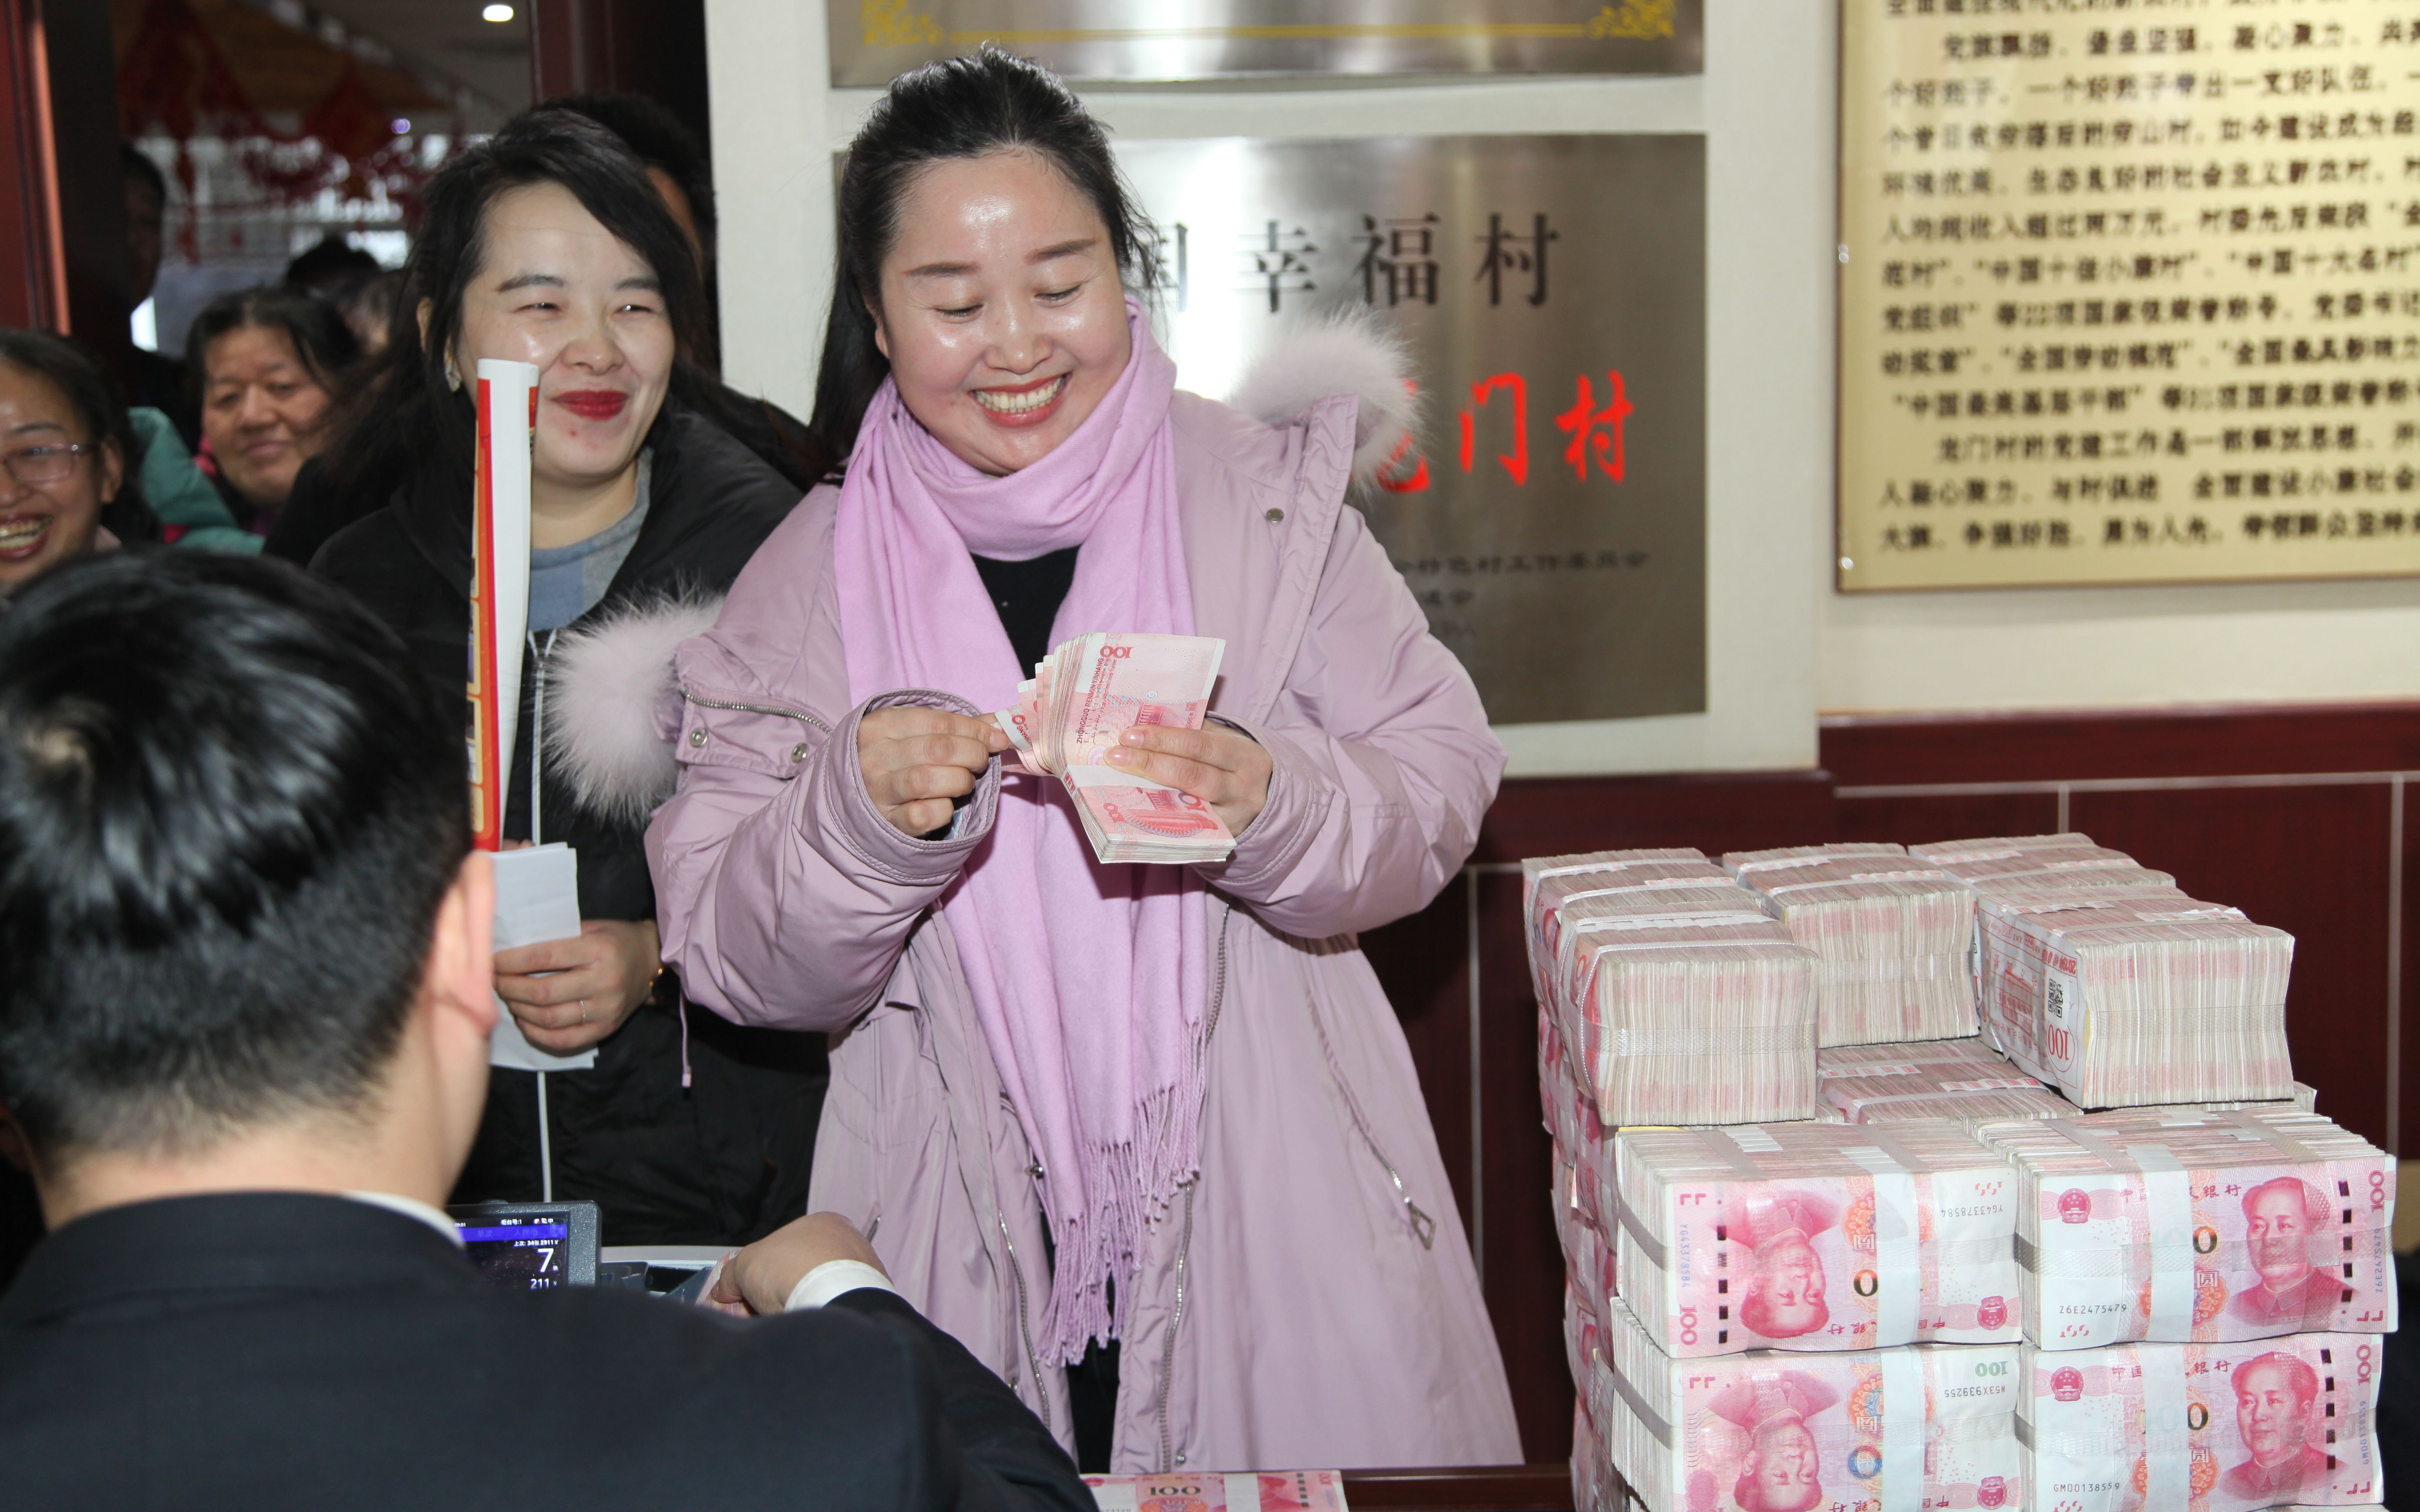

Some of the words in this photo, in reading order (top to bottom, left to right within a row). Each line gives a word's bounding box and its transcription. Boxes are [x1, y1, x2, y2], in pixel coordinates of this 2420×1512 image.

[1077, 709, 1090, 743] ZHONGGUO
[1085, 685, 1096, 707] RENMIN
[1092, 658, 1104, 686] YINHANG
[2048, 1024, 2069, 1061] 100
[2368, 1170, 2385, 1213] 100
[1940, 1203, 2003, 1220] YG43378584
[538, 1248, 554, 1272] 7
[530, 1278, 549, 1289] 211
[2059, 1304, 2127, 1315] Z6E2475479
[1679, 1304, 1699, 1346] 100
[1974, 1360, 2009, 1377] 100
[2356, 1344, 2371, 1386] 100
[1944, 1385, 2006, 1399] W53X939255
[1150, 1485, 1202, 1496] 100
[2053, 1481, 2120, 1494] GM00138559
